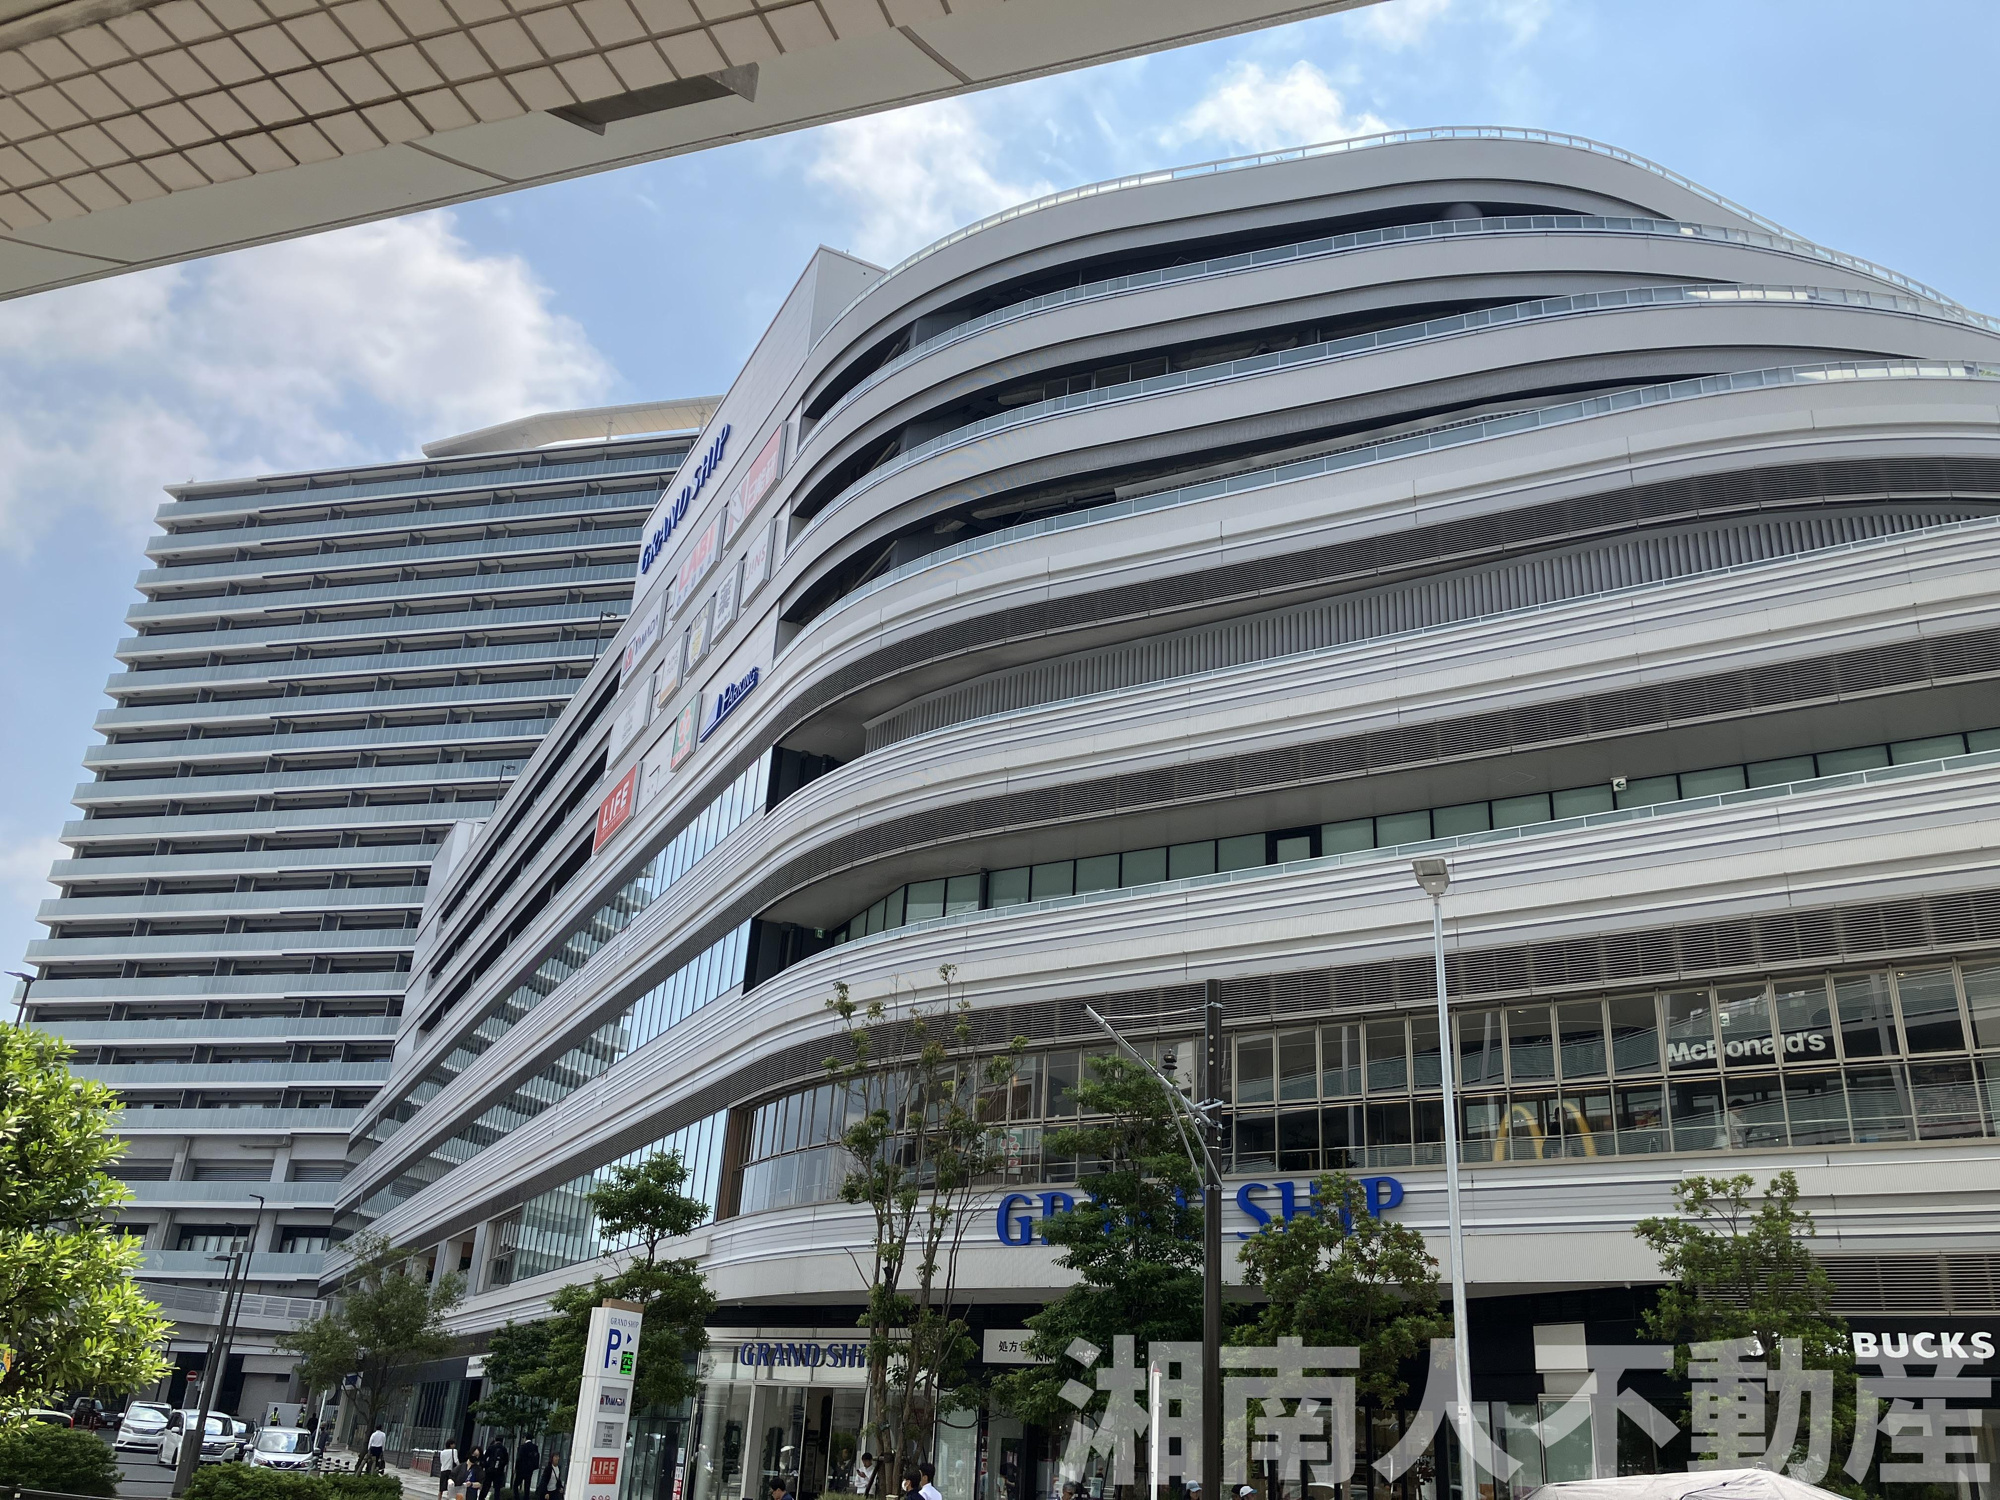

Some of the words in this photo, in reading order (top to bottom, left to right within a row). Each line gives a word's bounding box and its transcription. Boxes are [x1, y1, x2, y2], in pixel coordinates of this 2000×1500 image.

[641, 485, 690, 574] GRAND
[691, 423, 731, 500] SHIP
[679, 522, 716, 593] LABI
[676, 553, 712, 608] OFUNA
[602, 780, 630, 829] LIFE
[610, 1317, 628, 1327] GRAND
[604, 1328, 622, 1368] P
[620, 1351, 634, 1375] 空
[740, 1342, 821, 1367] GRAND
[592, 1461, 615, 1475] LIFE
